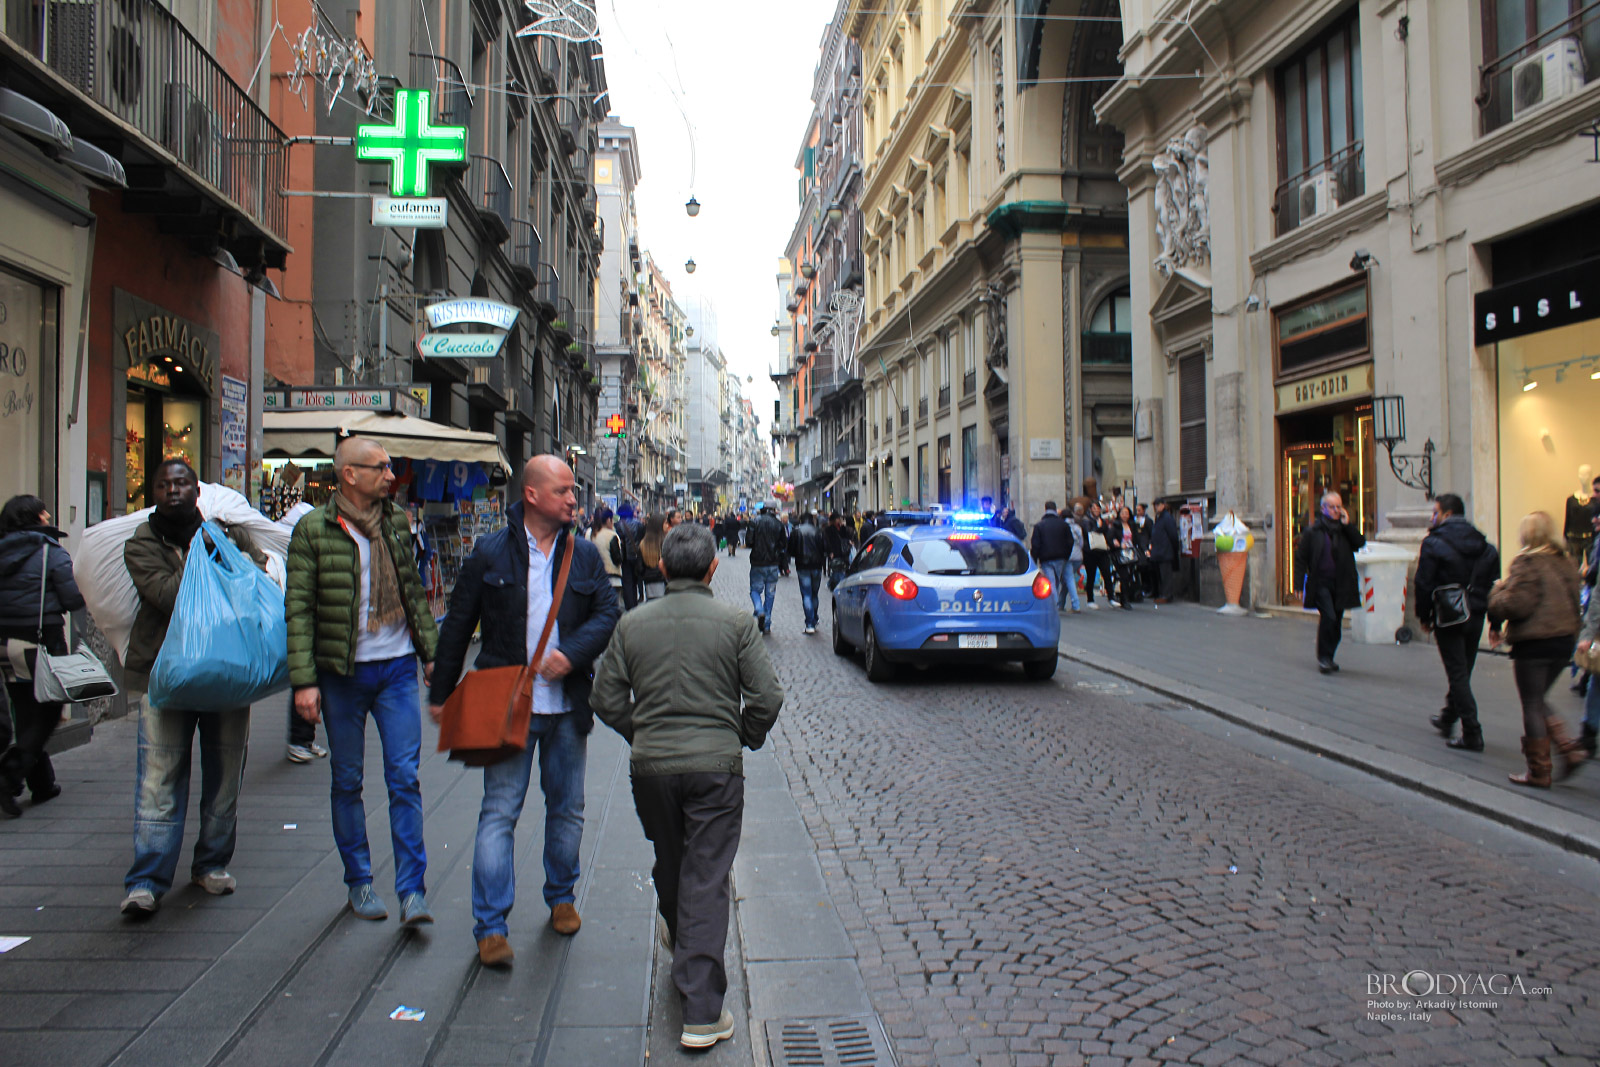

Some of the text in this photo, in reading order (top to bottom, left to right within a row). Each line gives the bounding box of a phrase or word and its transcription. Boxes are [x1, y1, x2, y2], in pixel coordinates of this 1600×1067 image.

[390, 202, 441, 213] eufarma
[433, 300, 511, 326] RISTORANTE
[1485, 290, 1581, 331] SISL
[125, 315, 214, 393] FARMACIA
[421, 336, 494, 353] al Cucciolo
[426, 463, 437, 484] 7
[453, 462, 469, 488] 9
[940, 601, 1012, 613] POLIZIA
